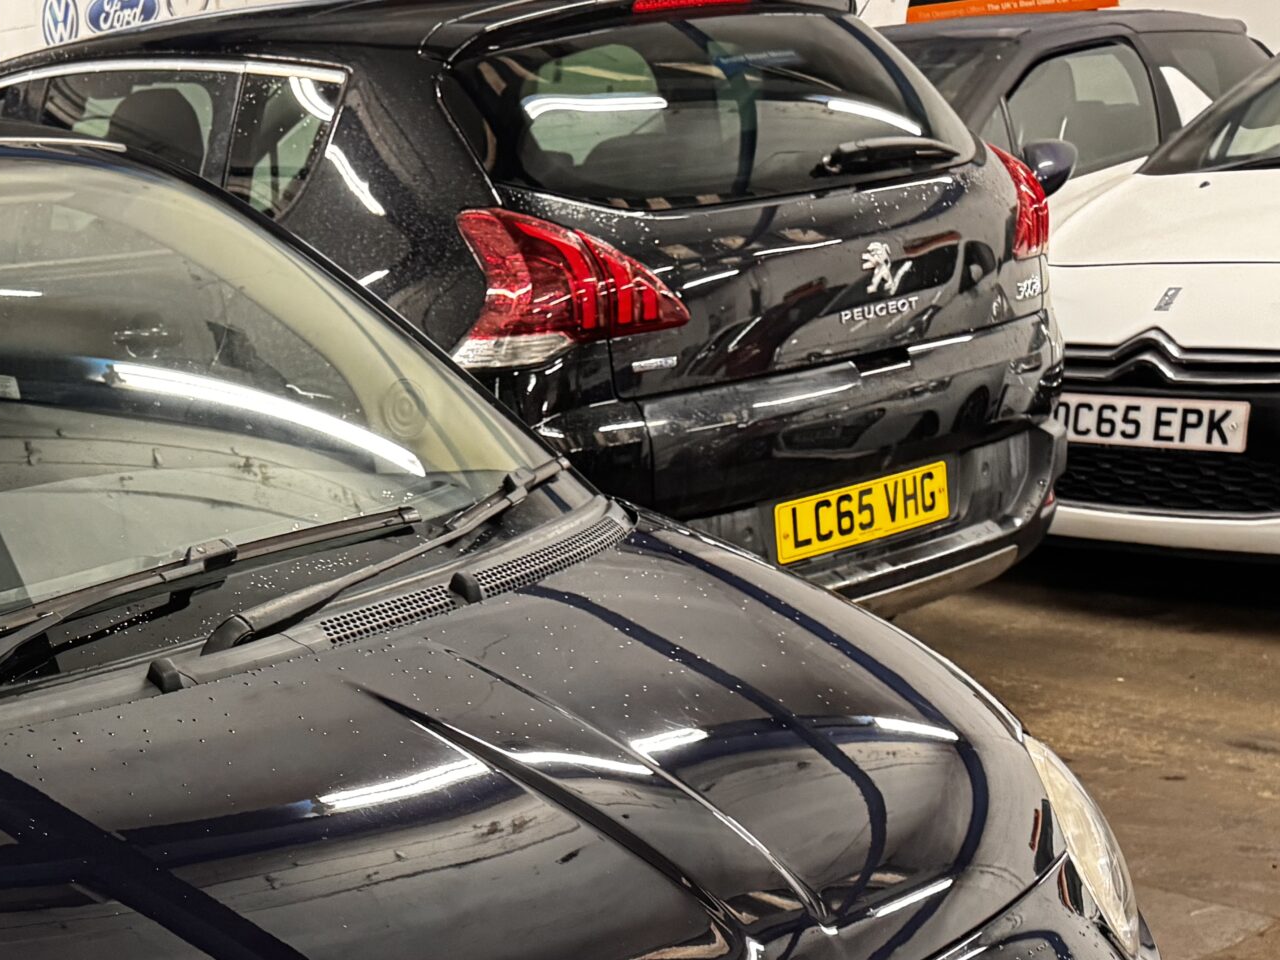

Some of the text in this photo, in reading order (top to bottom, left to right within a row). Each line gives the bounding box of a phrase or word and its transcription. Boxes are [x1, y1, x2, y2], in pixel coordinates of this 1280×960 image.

[100, 0, 145, 30] Ford
[840, 295, 919, 324] PEUGEOT
[1153, 406, 1232, 446] EPK
[791, 471, 937, 550] LC65 VHG
